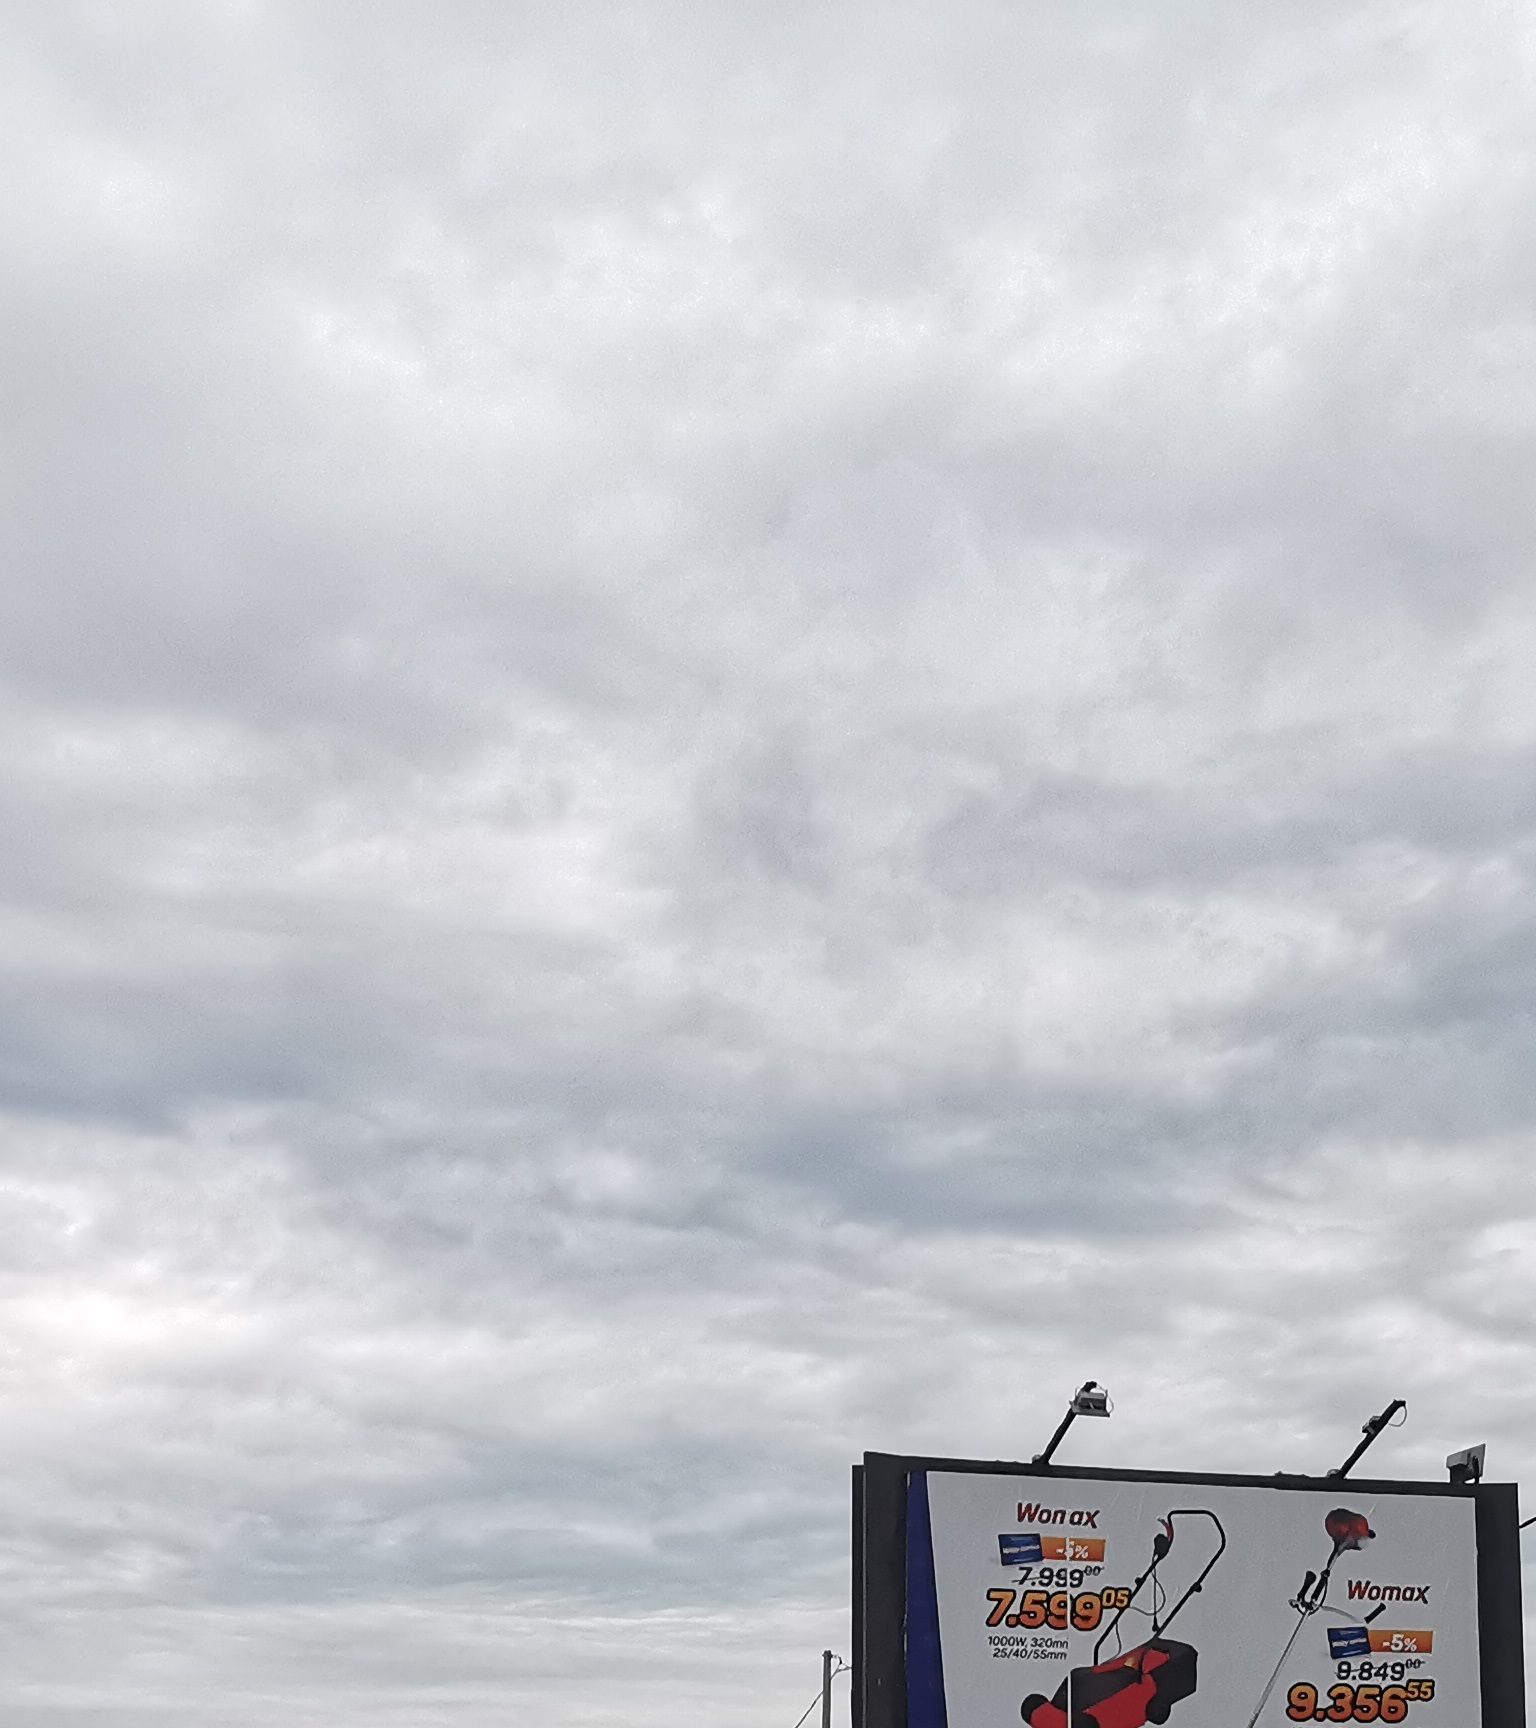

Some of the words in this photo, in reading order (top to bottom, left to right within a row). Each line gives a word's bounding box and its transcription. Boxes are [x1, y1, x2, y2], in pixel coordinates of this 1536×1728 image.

[1347, 1579, 1431, 1604] Womax
[988, 1635, 1028, 1648] 1000W,
[1382, 1634, 1417, 1652] -5%
[992, 1648, 1068, 1660] 25/40/55mm
